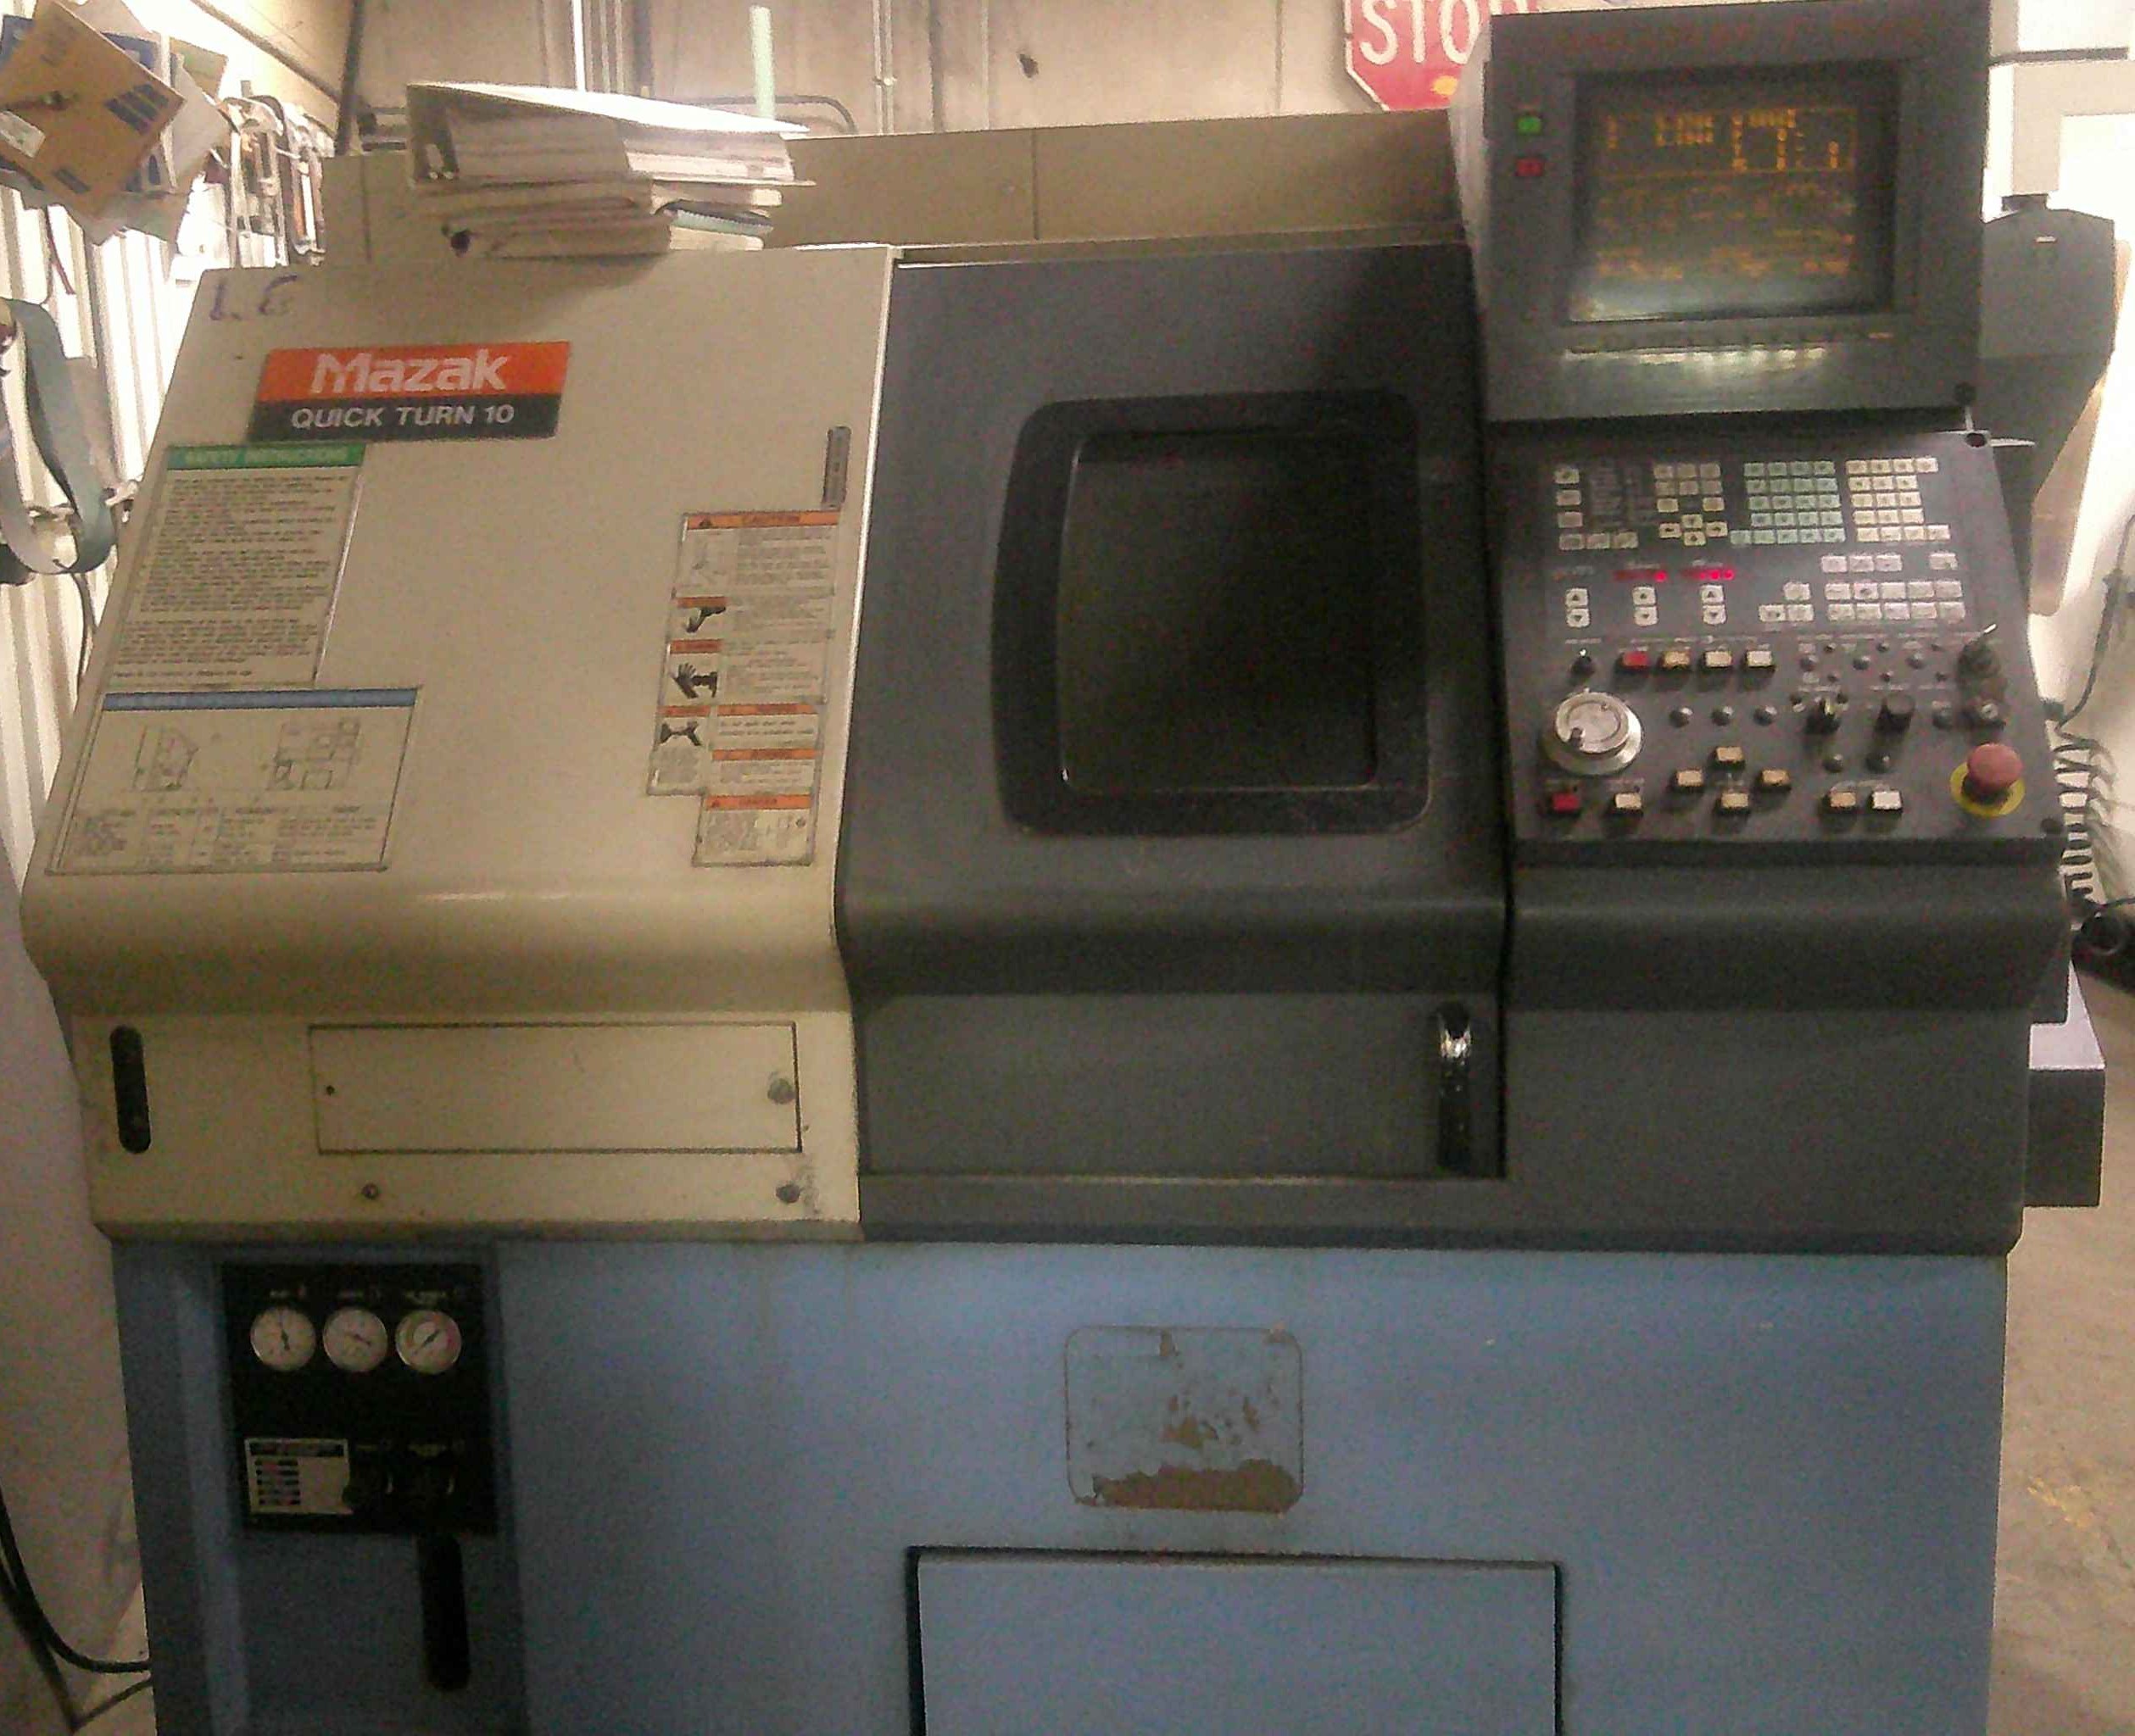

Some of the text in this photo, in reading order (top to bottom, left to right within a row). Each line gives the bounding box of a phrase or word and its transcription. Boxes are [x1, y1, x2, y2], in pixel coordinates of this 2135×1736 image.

[1360, 0, 1528, 64] STO
[309, 348, 507, 394] Mazak
[291, 404, 515, 428] QUICK TURN 10
